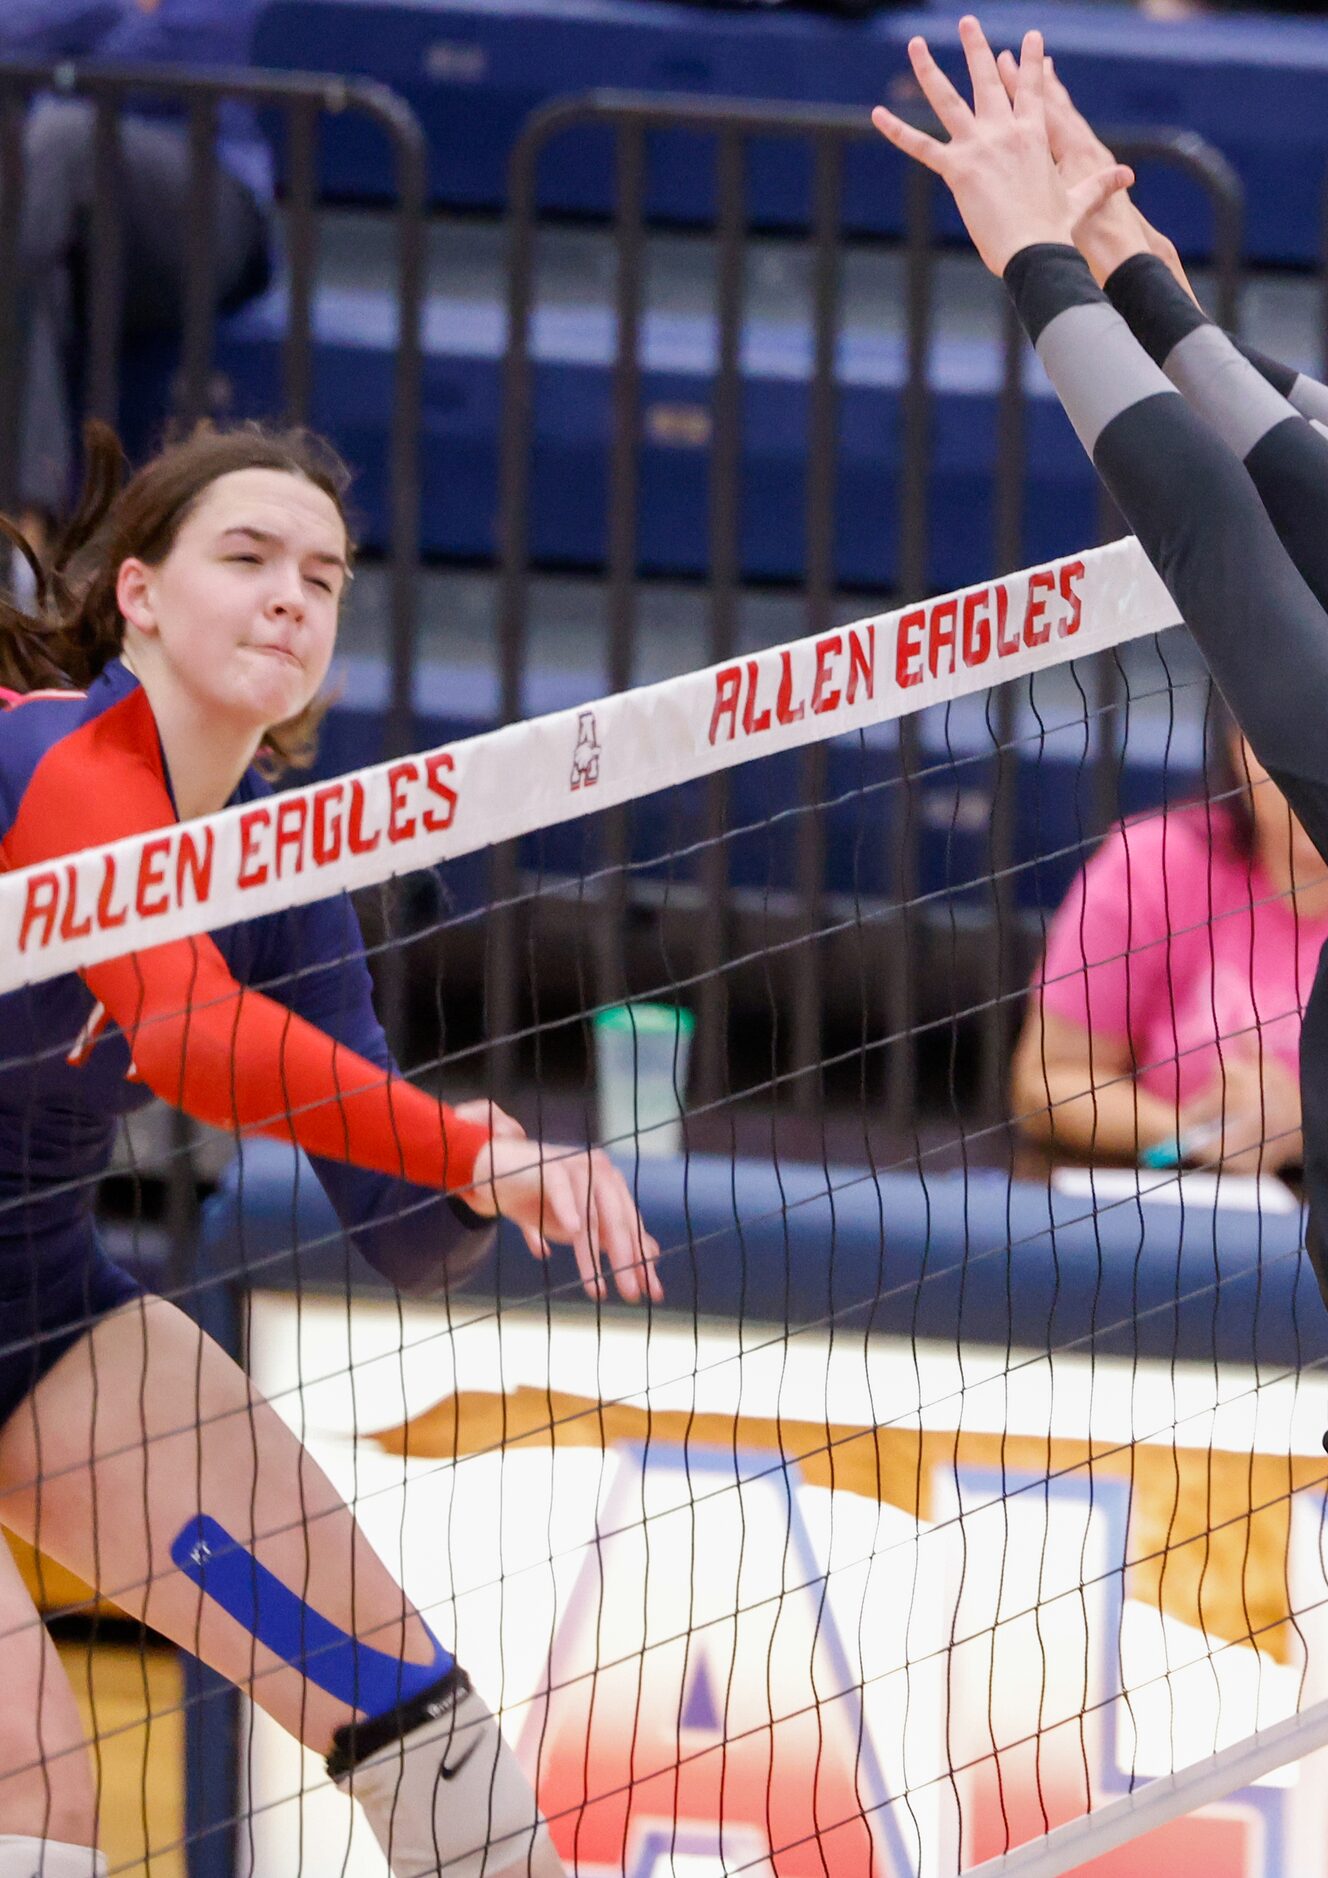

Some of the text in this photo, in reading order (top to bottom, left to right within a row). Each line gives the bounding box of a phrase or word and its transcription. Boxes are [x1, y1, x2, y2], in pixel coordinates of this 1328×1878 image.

[709, 560, 1087, 744] ALLEN EAGLES
[16, 752, 459, 953] ALLEN EAGLES
